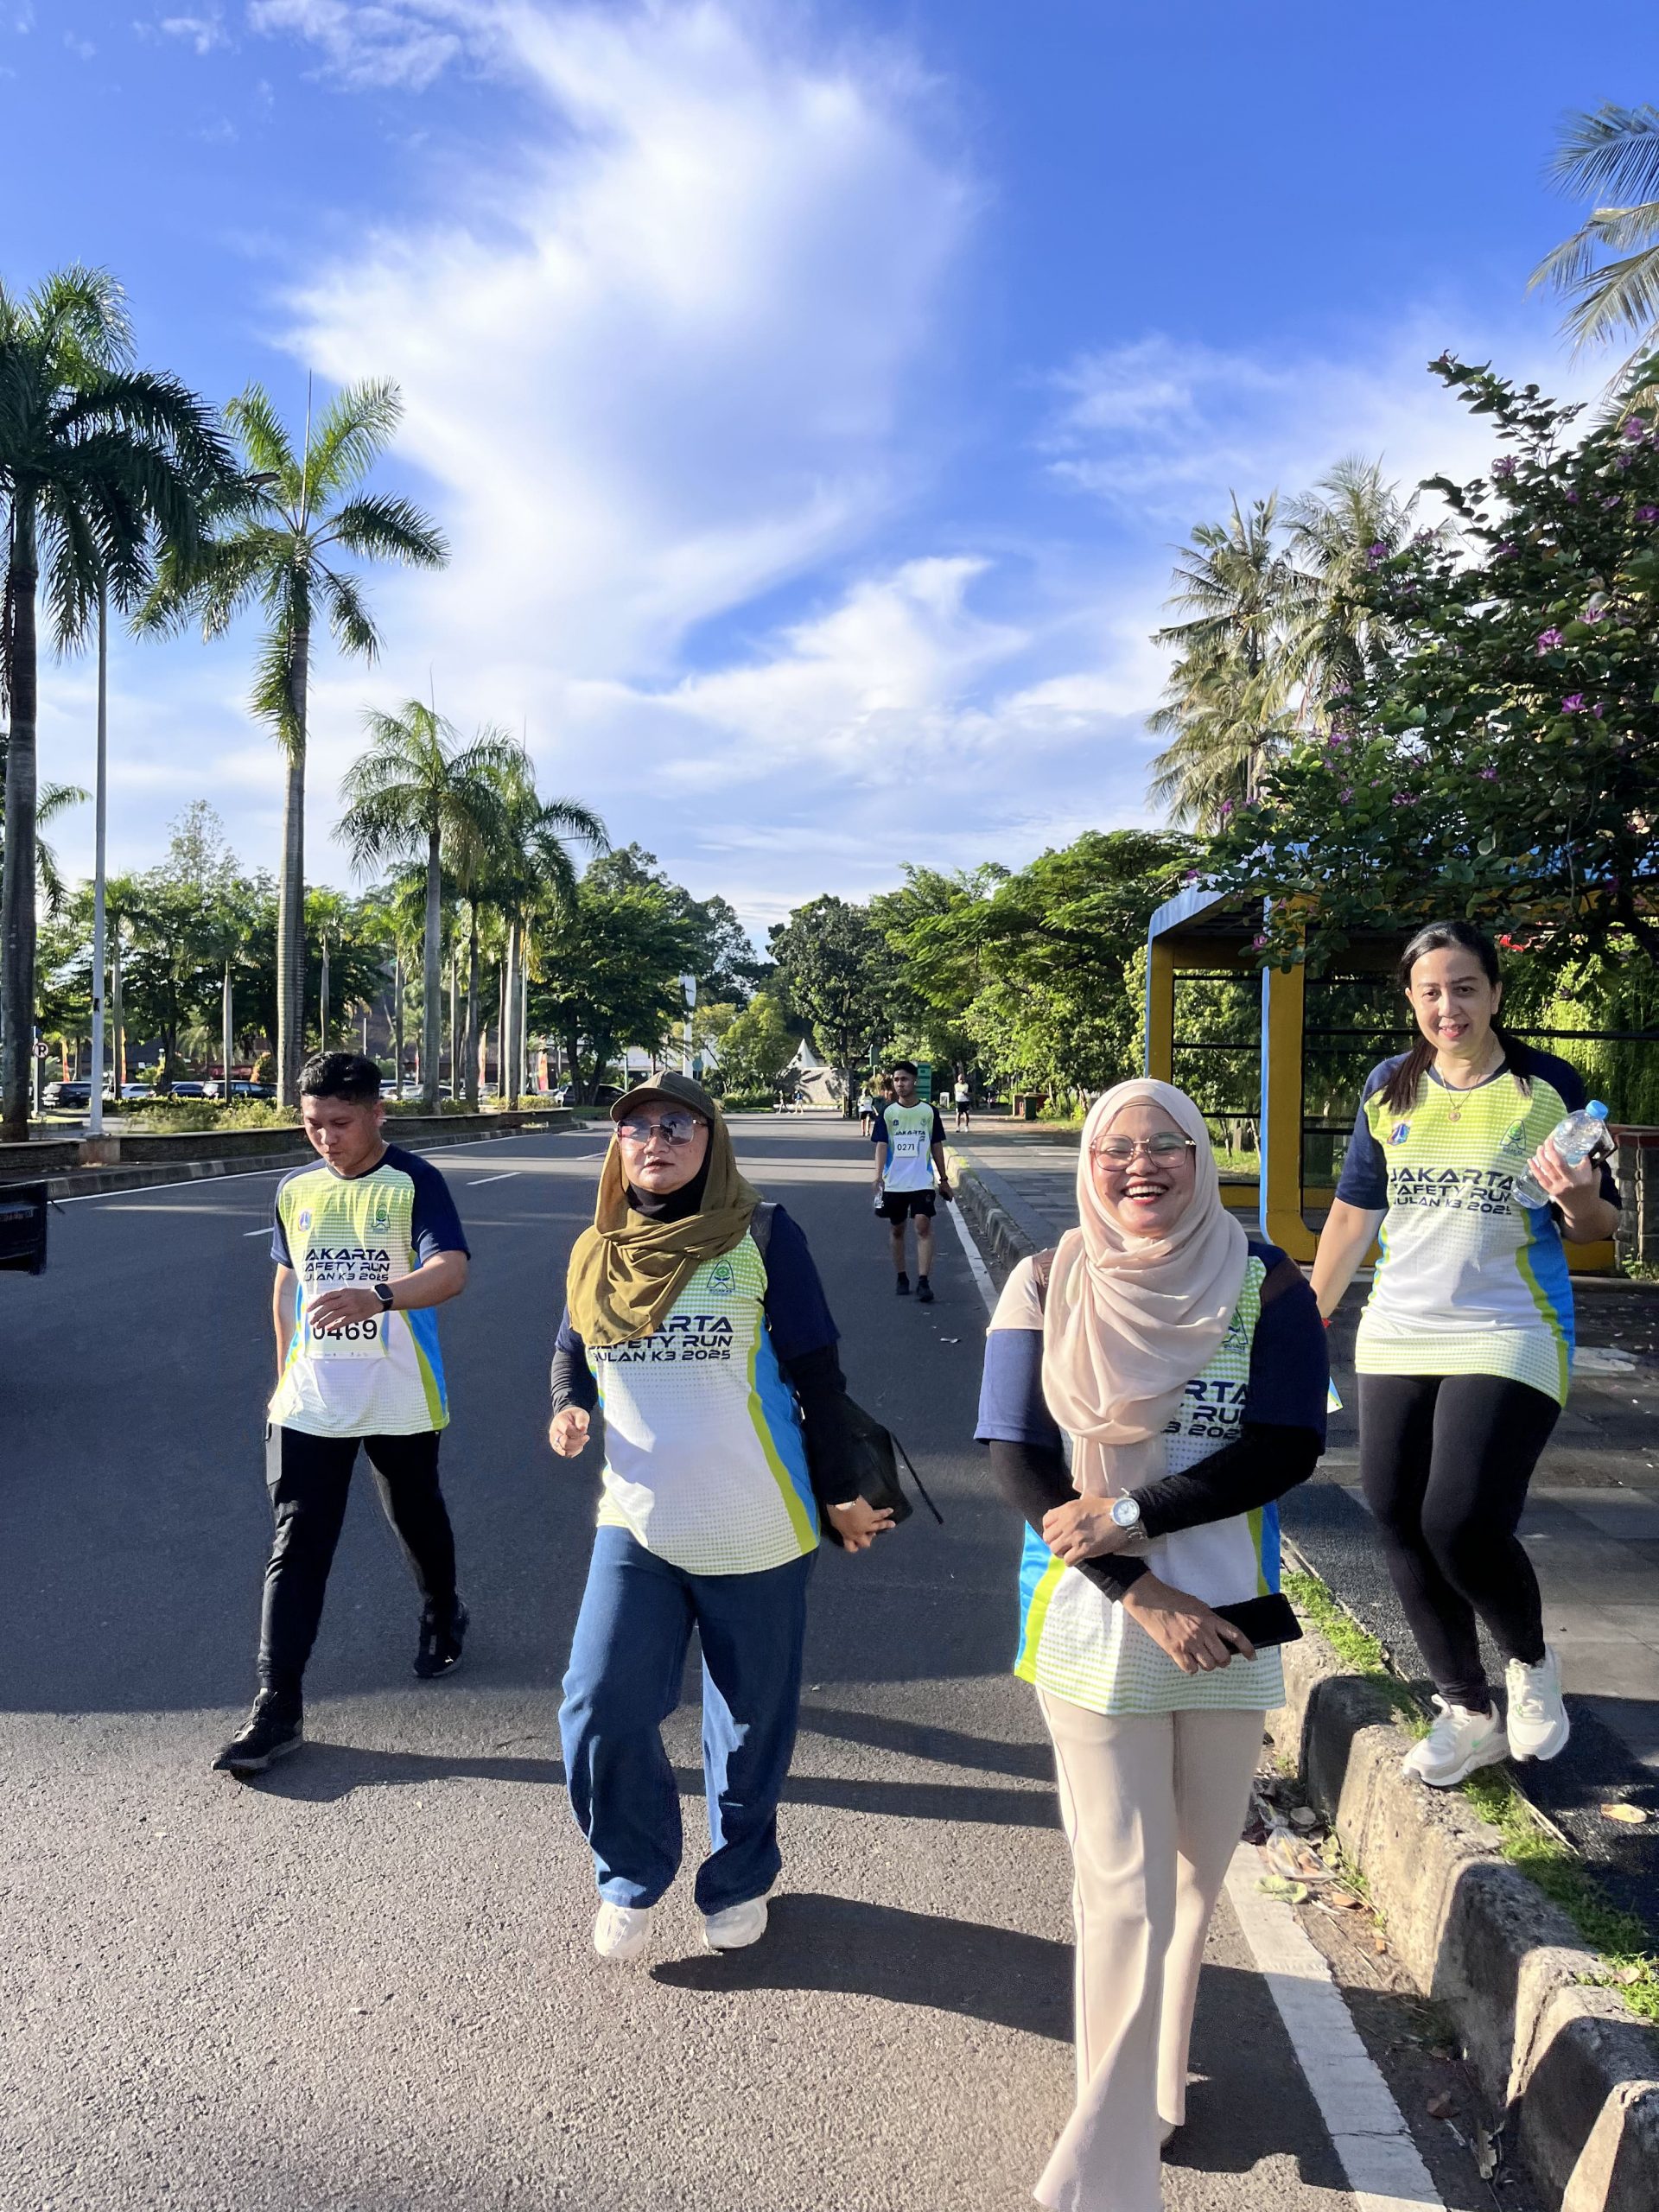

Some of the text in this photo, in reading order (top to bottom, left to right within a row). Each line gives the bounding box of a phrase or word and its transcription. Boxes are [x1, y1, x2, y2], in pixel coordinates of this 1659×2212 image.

[1390, 1167, 1514, 1190] JAKARTA
[1395, 1184, 1465, 1197] AFETY
[1394, 1197, 1440, 1207] ULAN
[304, 1248, 391, 1261] AKARTA
[304, 1262, 391, 1273] AFETY RUN
[313, 1319, 378, 1340] 0469
[682, 1335, 734, 1348] RUN
[652, 1351, 677, 1362] K3
[681, 1350, 731, 1361] 2025
[1188, 1423, 1241, 1440] 202
